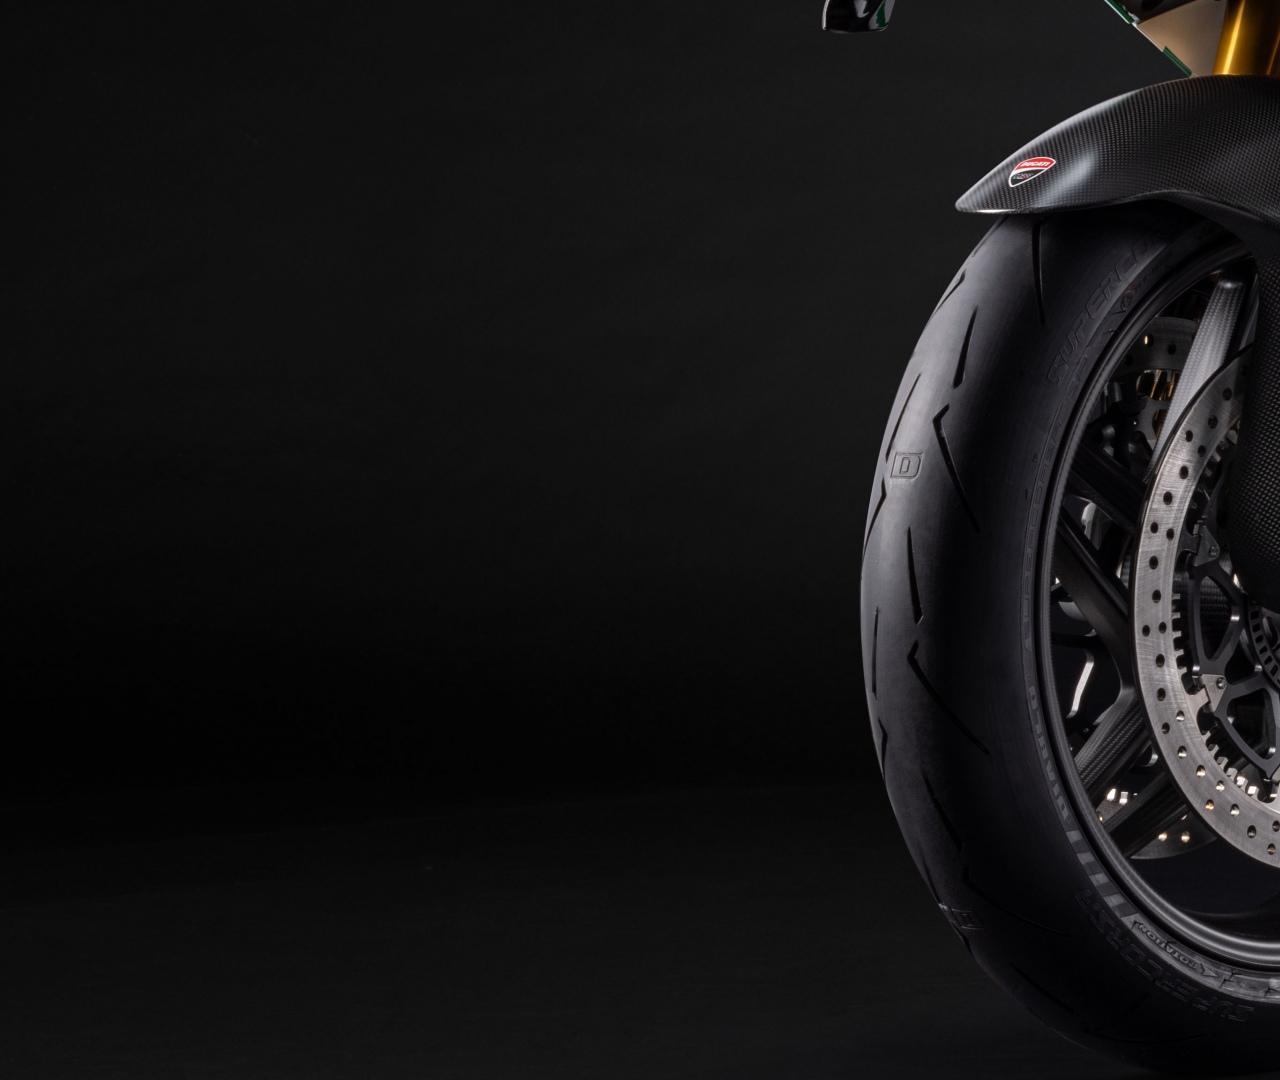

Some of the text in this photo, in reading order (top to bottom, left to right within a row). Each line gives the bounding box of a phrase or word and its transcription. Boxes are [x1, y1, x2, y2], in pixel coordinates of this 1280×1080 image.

[1028, 685, 1069, 820] DIABLO
[1074, 890, 1255, 1022] SUPERCORSA
[1138, 923, 1199, 970] ROTATION
